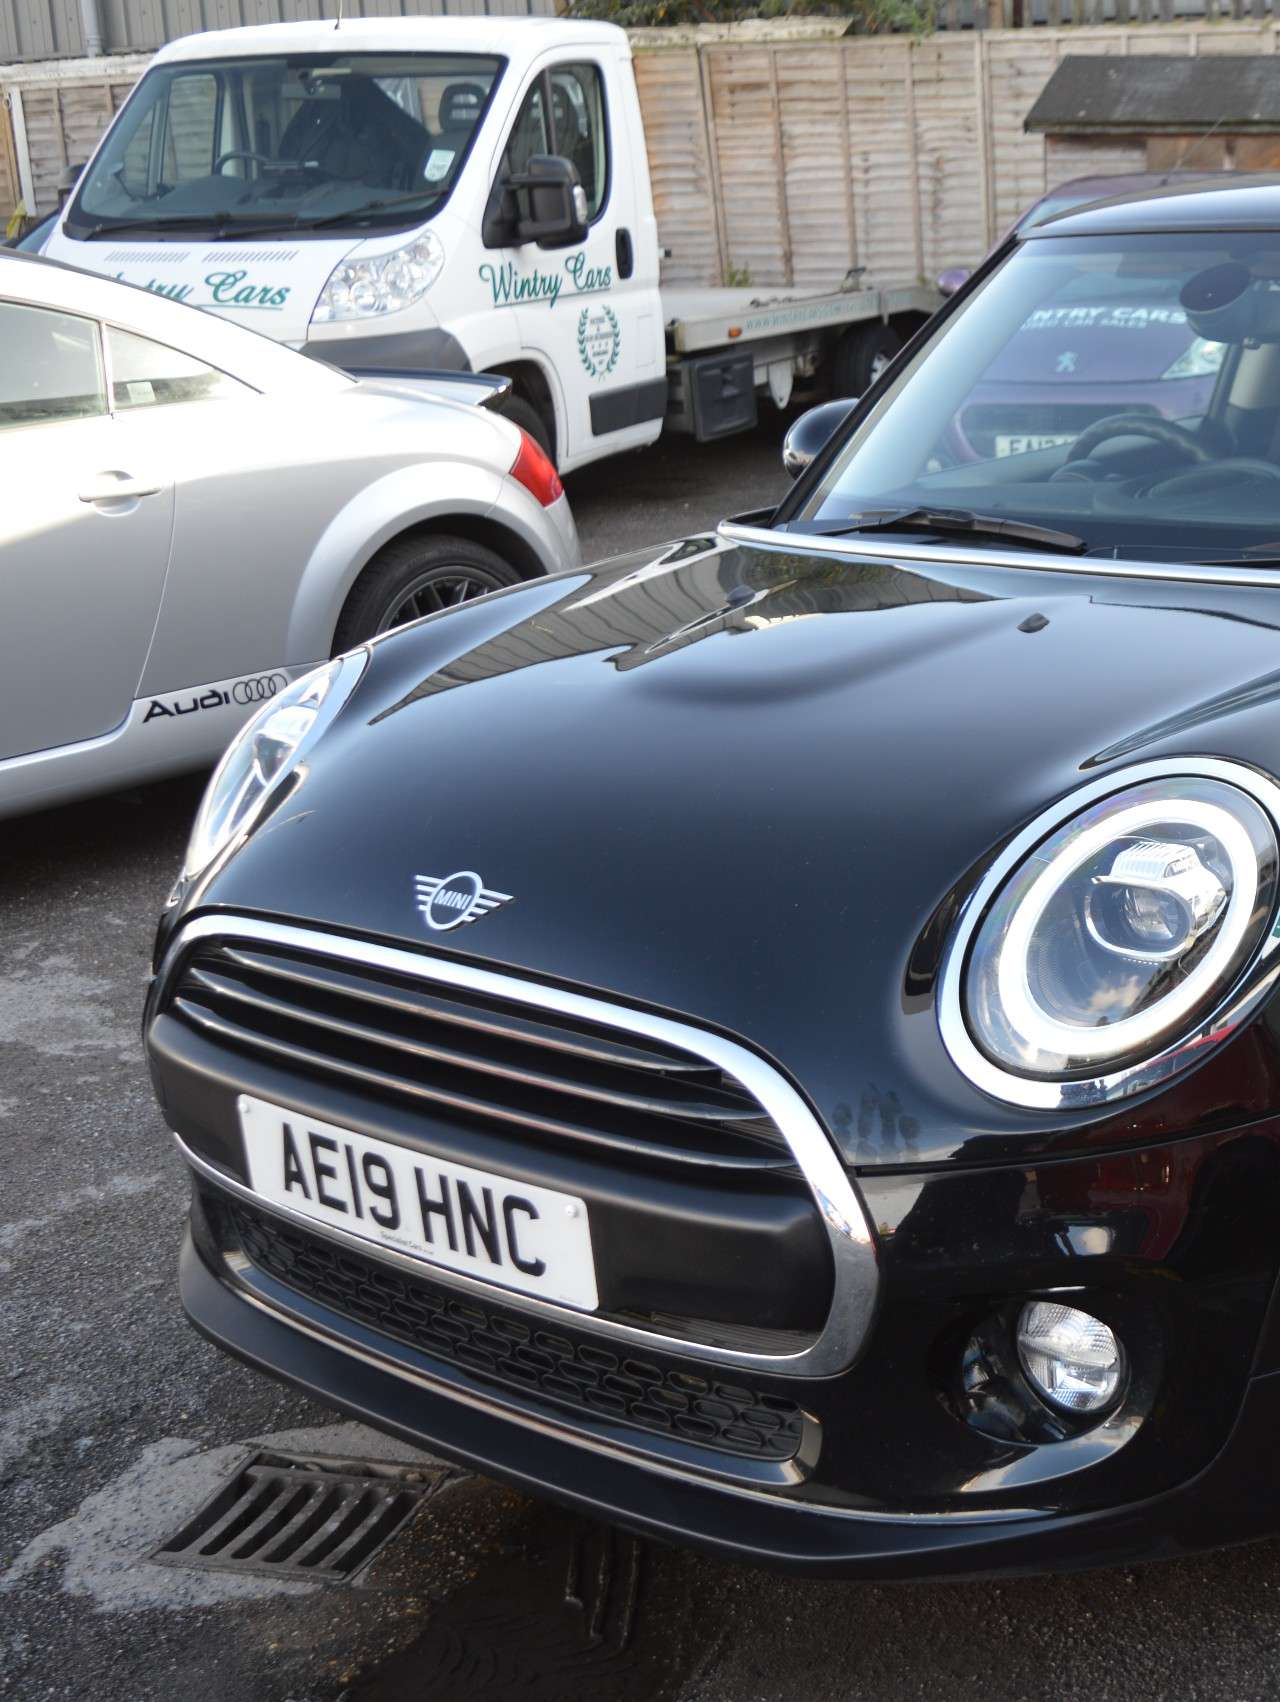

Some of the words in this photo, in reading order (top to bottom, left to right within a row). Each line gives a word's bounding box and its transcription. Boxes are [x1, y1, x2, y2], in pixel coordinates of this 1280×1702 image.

[204, 270, 291, 305] Cars
[479, 261, 563, 308] Wintry
[564, 252, 612, 290] Cars
[1111, 308, 1188, 324] CARS
[142, 690, 230, 723] Audi
[434, 888, 472, 910] MINI
[283, 1122, 400, 1230] AE19
[415, 1166, 546, 1277] HNC
